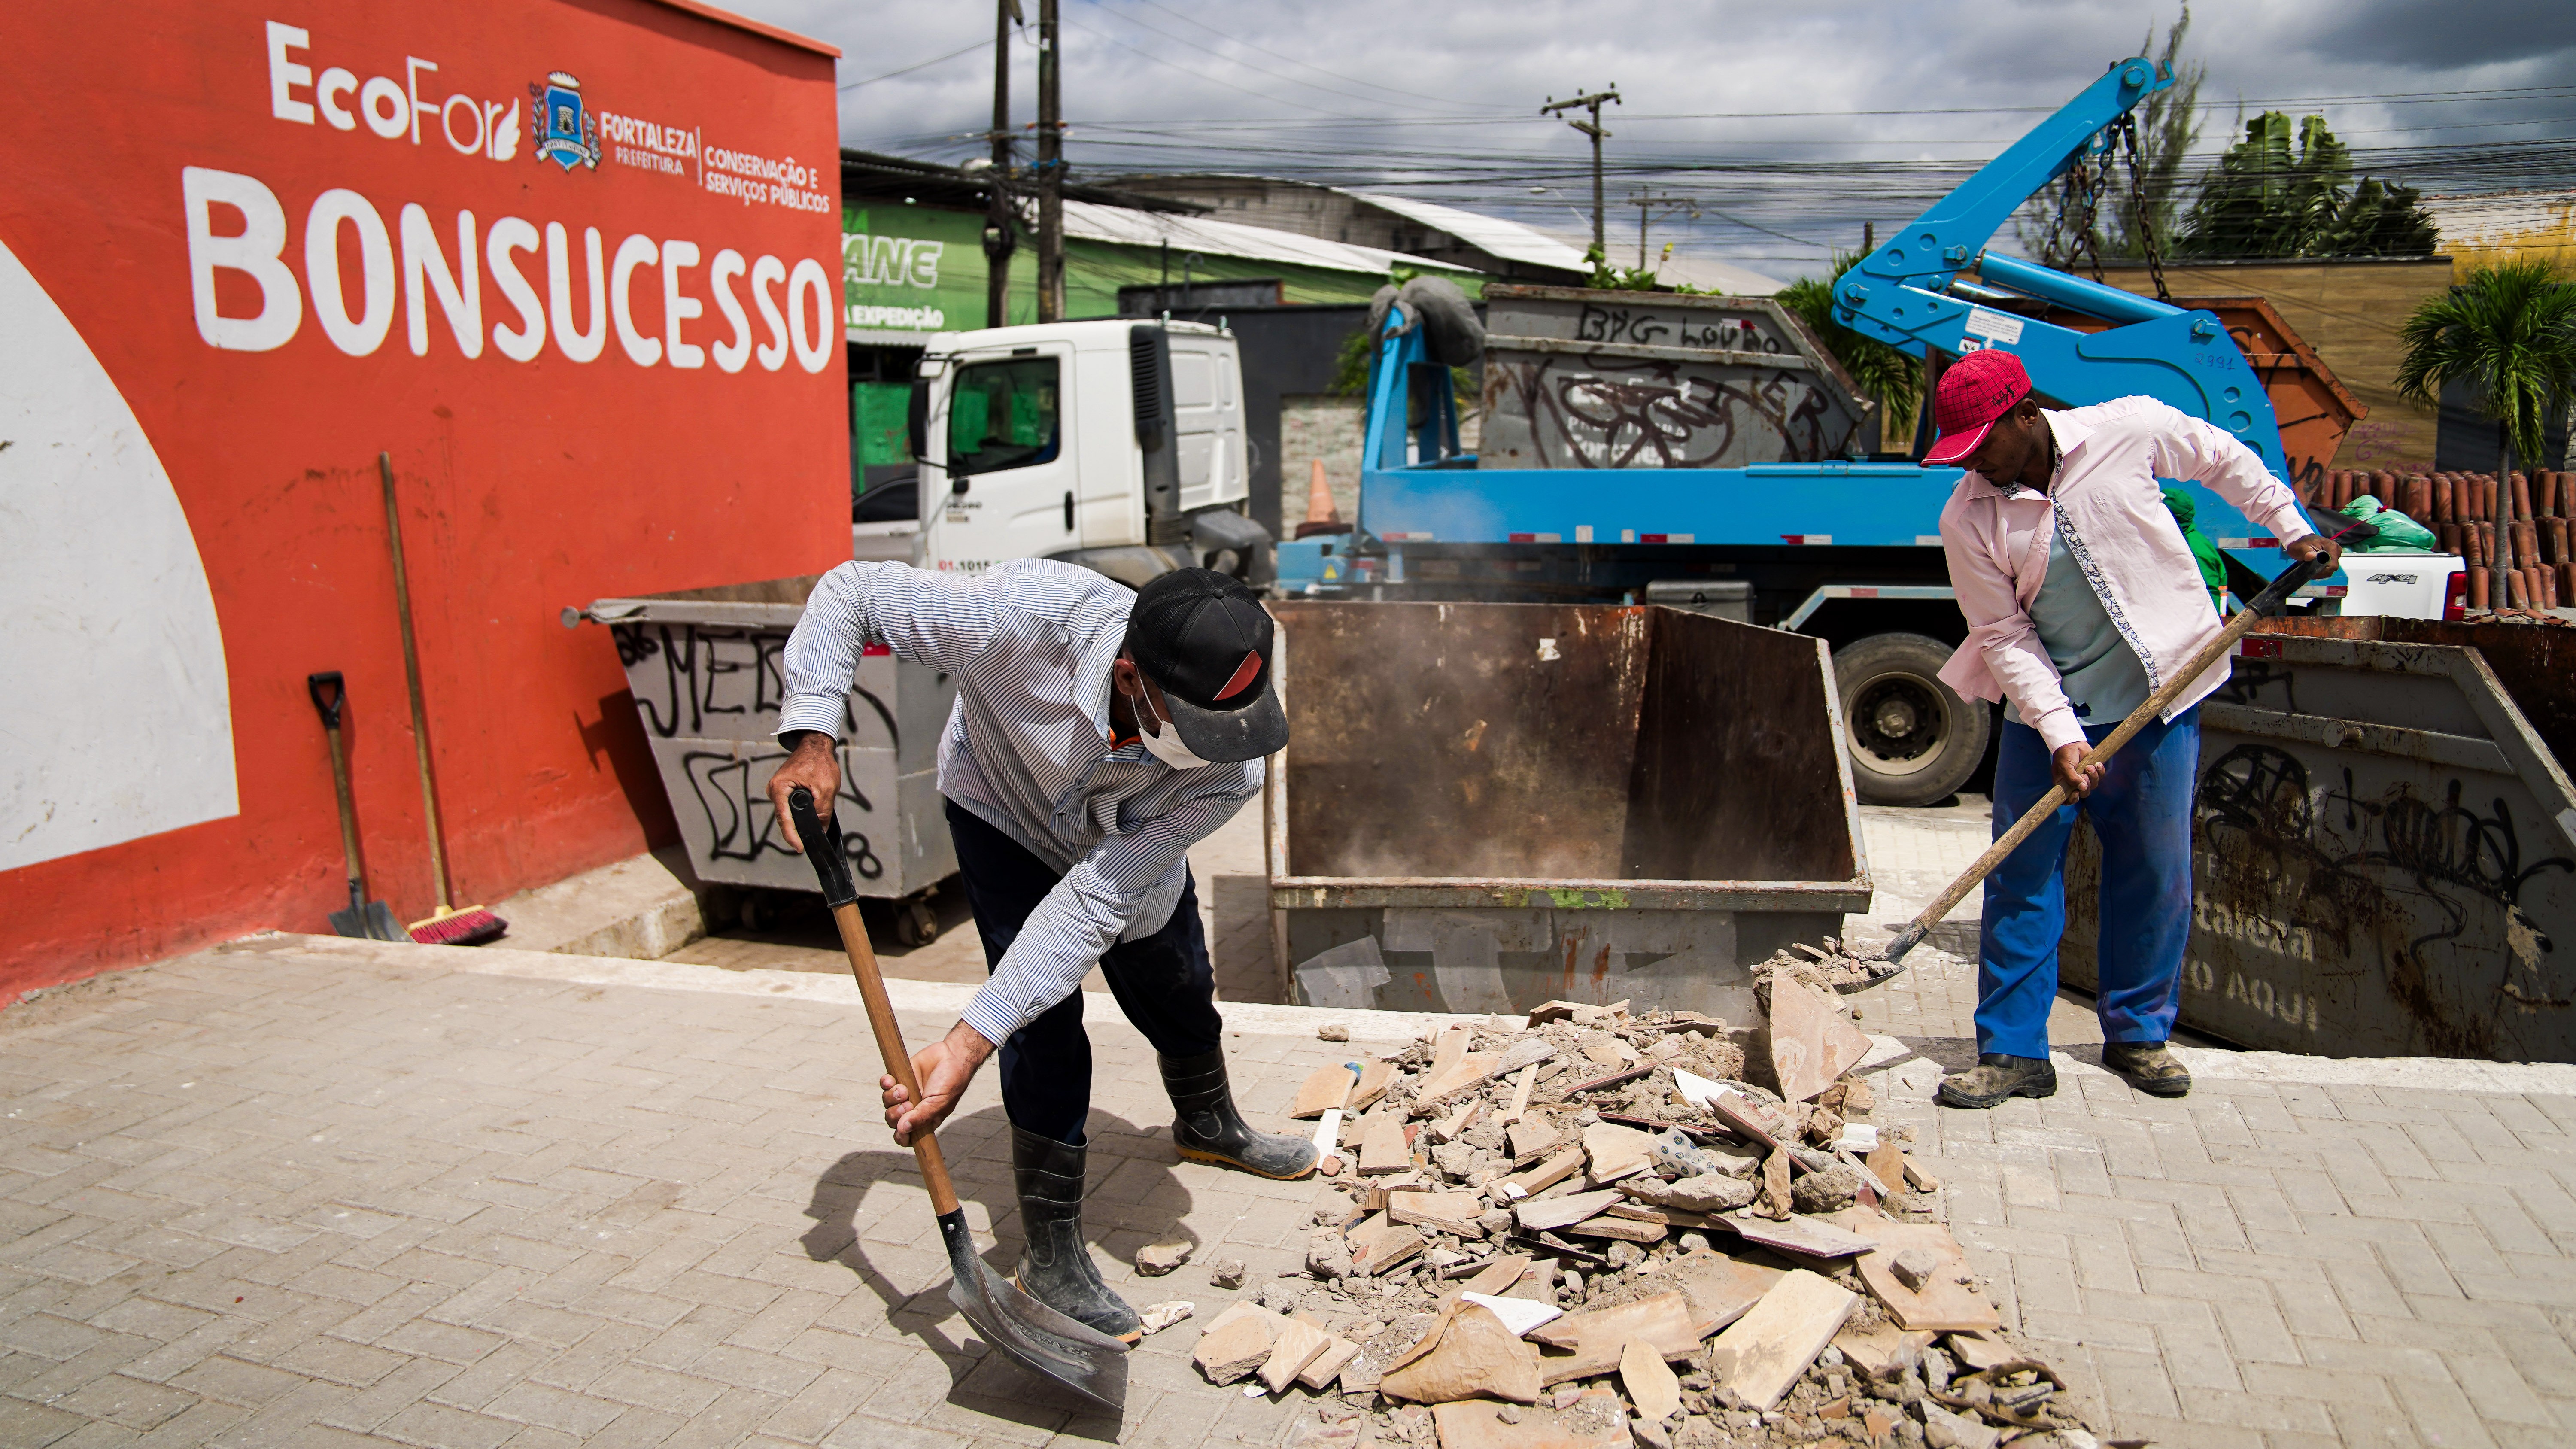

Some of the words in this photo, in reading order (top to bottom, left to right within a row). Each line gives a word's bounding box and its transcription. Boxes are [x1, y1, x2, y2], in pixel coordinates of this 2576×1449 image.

[266, 20, 504, 160] EcoFor
[601, 111, 697, 158] FORTALEZA
[615, 146, 684, 175] PREFEITURA
[704, 146, 807, 188] CONSERVAÇÃO
[808, 167, 818, 189] E
[705, 171, 768, 206] SERVIÇOS
[183, 167, 834, 374] BONSUCESSO
[852, 304, 944, 331] EXPEDIÇÃO
